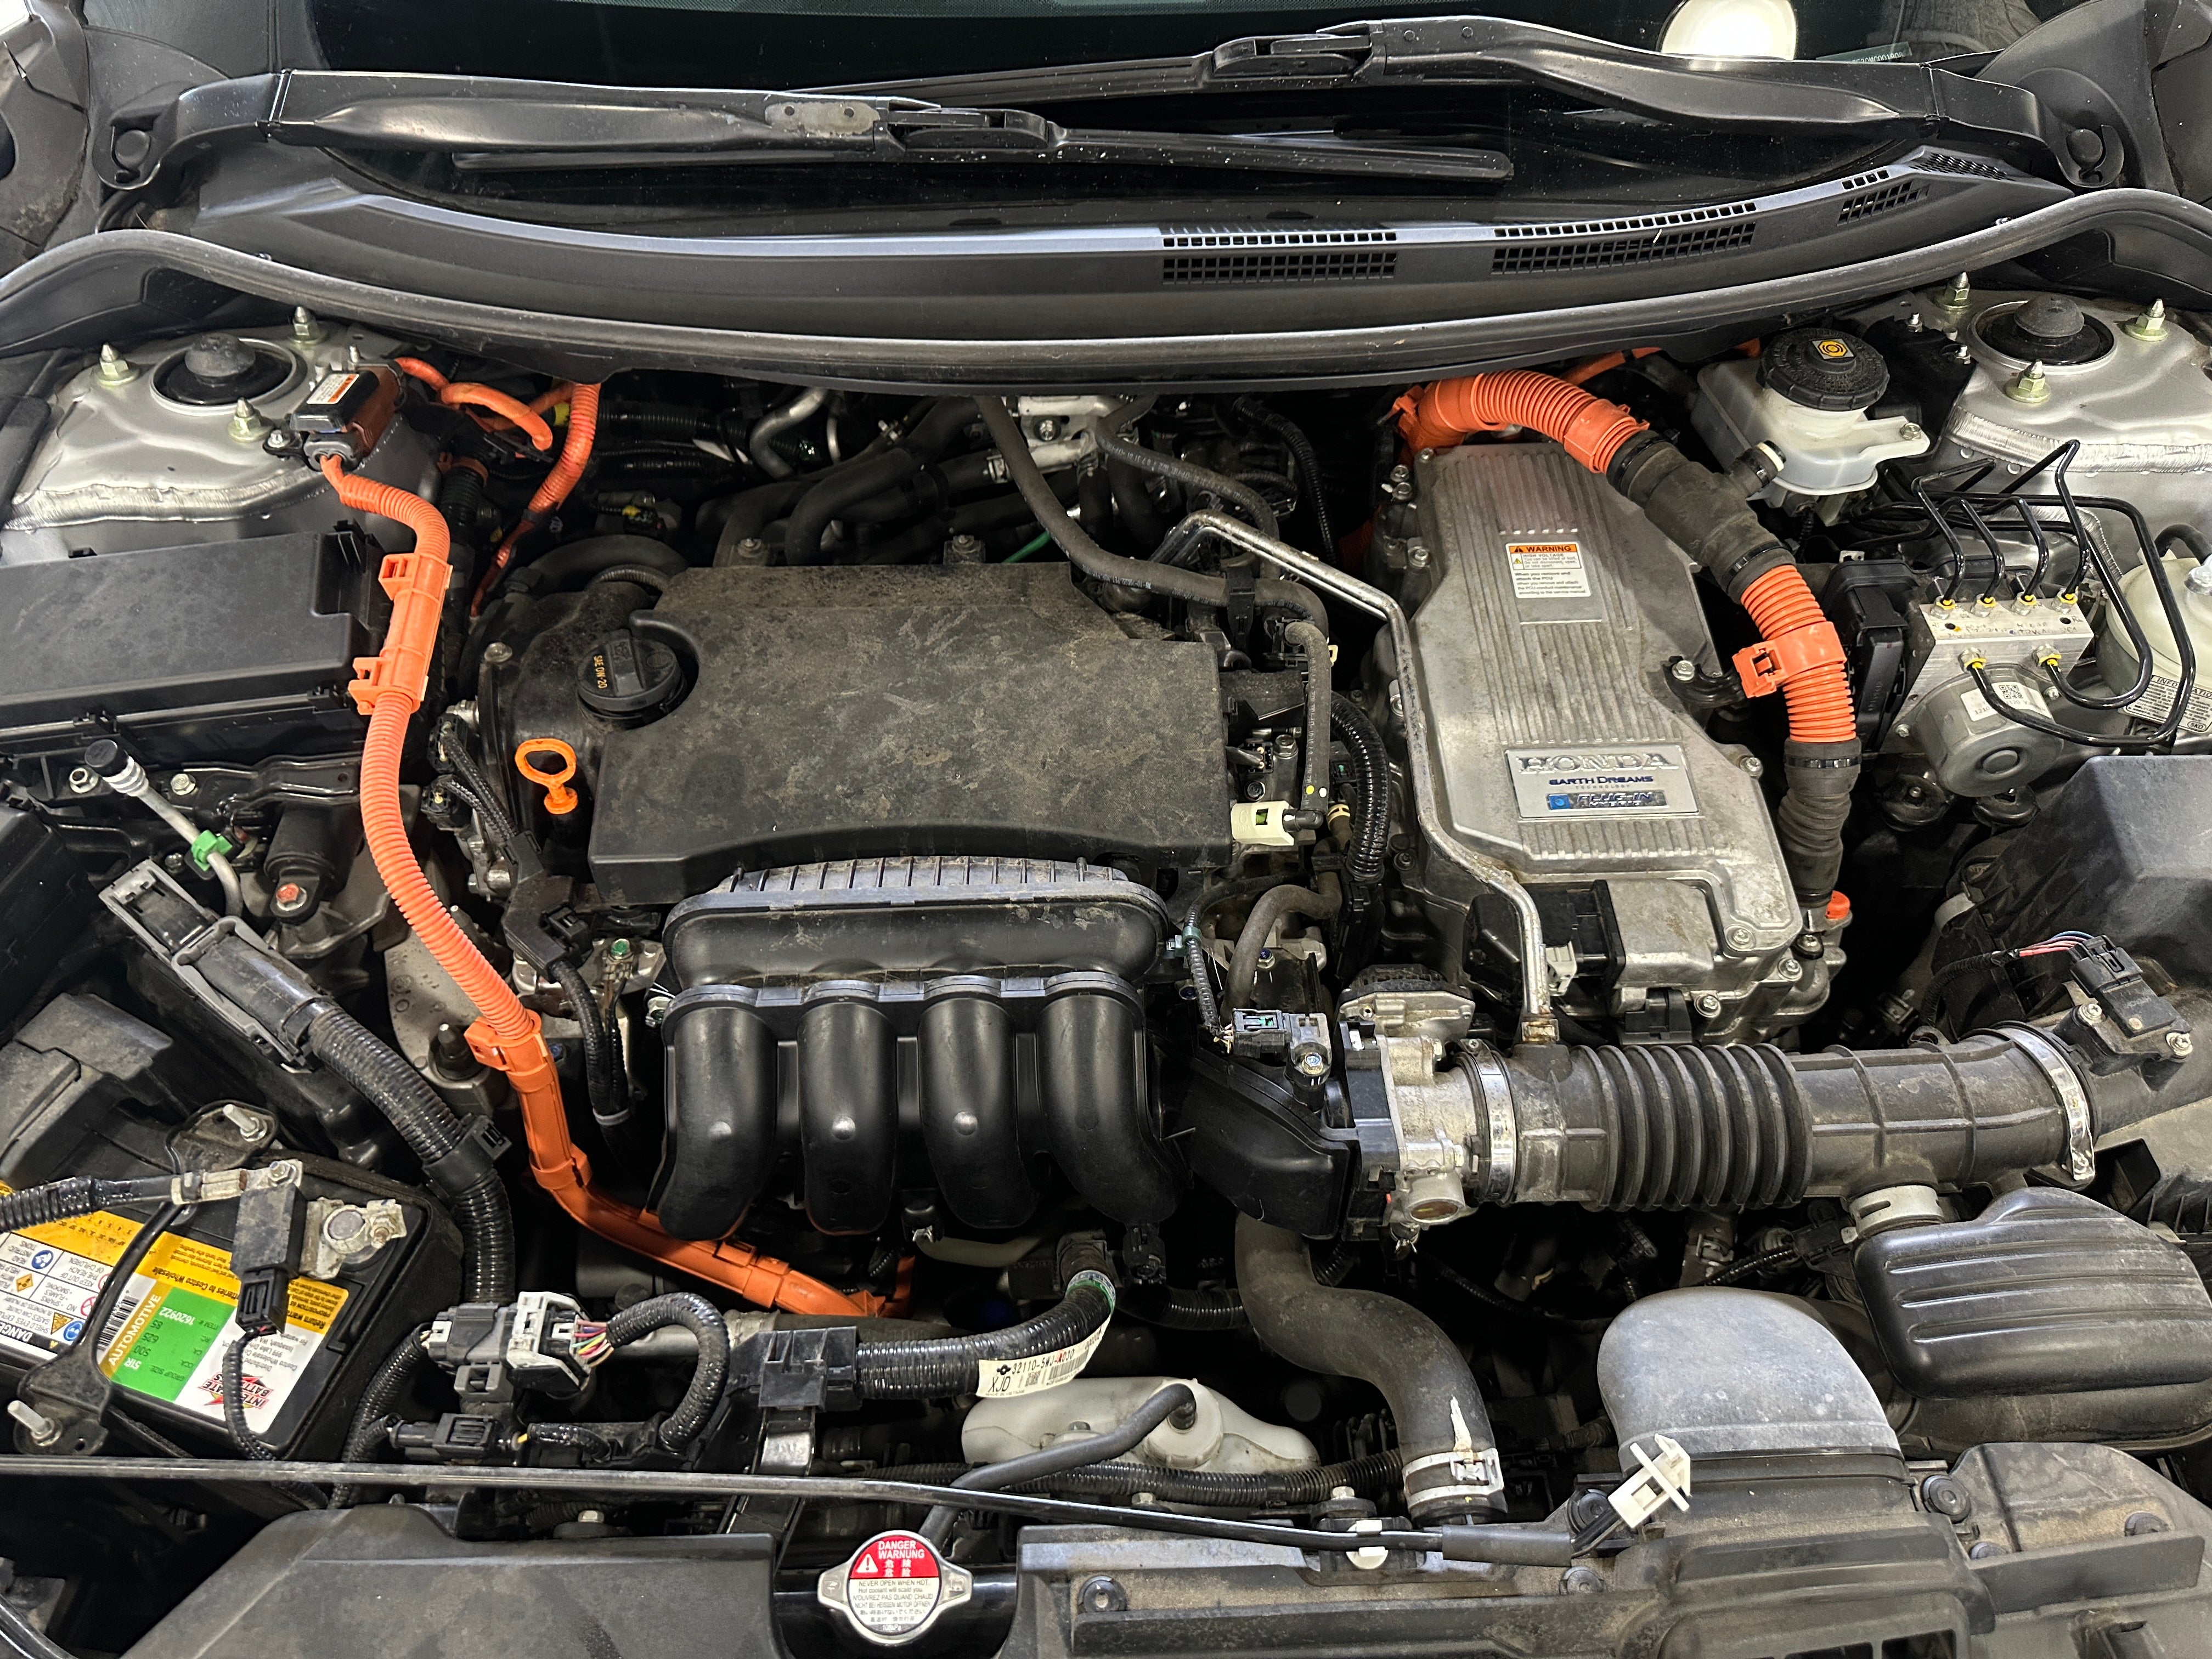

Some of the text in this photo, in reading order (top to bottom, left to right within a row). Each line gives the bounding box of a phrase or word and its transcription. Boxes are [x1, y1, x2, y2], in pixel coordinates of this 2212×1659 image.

[594, 655, 603, 667] SAE
[2157, 678, 2212, 697] INFOATIO
[1516, 753, 1679, 775] HONDA
[1577, 792, 1652, 802] PLUG-IN
[19, 1240, 37, 1251] TIONS
[4, 1266, 20, 1274] HELP
[69, 1267, 87, 1277] REACH
[45, 1282, 70, 1294] SMOKING
[80, 1279, 94, 1288] KEEP
[153, 1266, 239, 1300] tteries to Costco Wholesale
[43, 1289, 65, 1300] FLAMES
[41, 1296, 77, 1312] NO SPARKS
[159, 1306, 196, 1326] 1620922
[297, 1303, 330, 1318] PROPOSITION
[32, 1314, 51, 1325] GASES
[150, 1319, 163, 1330] 85
[303, 1315, 326, 1329] Return
[0, 1321, 33, 1342] DANGE
[29, 1323, 50, 1334] SHIELD
[108, 1294, 162, 1366] AUTOMOTIVE
[142, 1332, 159, 1344] 625
[133, 1345, 151, 1357] 500
[259, 1344, 273, 1355] Lake
[123, 1357, 142, 1370] 51R
[252, 1352, 298, 1372] Costco Wholesale
[212, 1373, 272, 1397] BATTS
[988, 1376, 1011, 1392] XJD
[202, 1380, 267, 1407] INTEATE
[878, 1540, 916, 1550] DANGER
[878, 1549, 925, 1559] WARNUNG
